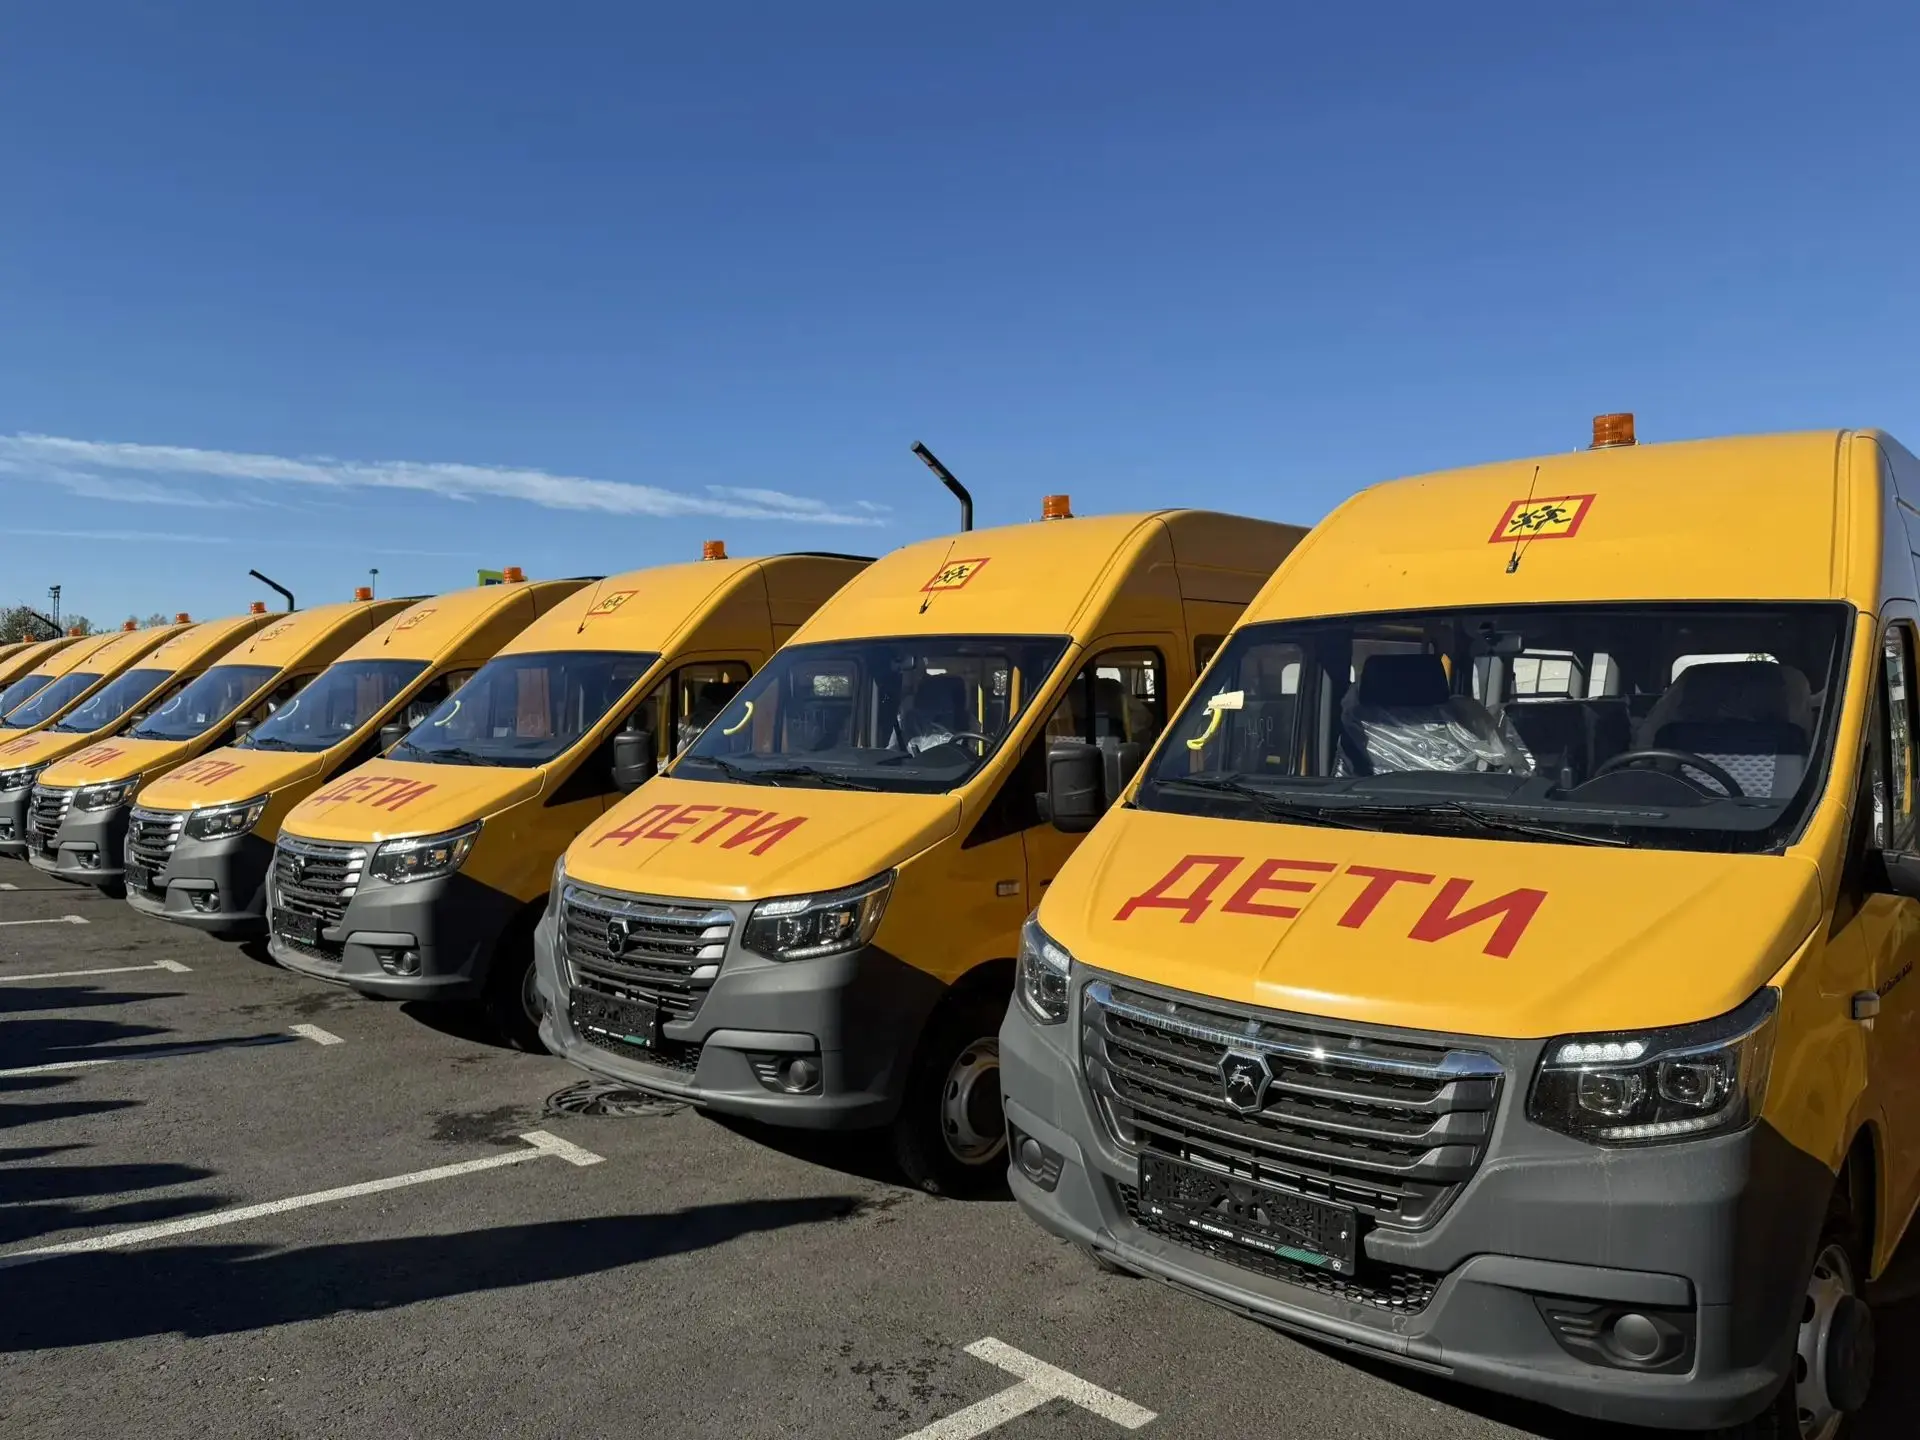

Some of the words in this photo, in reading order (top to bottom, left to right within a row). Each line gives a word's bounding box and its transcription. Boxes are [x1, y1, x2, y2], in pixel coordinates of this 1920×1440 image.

[300, 776, 438, 812] ДЕТИ
[589, 804, 809, 857] ДЕТИ
[1112, 854, 1549, 960] ДЕТИ
